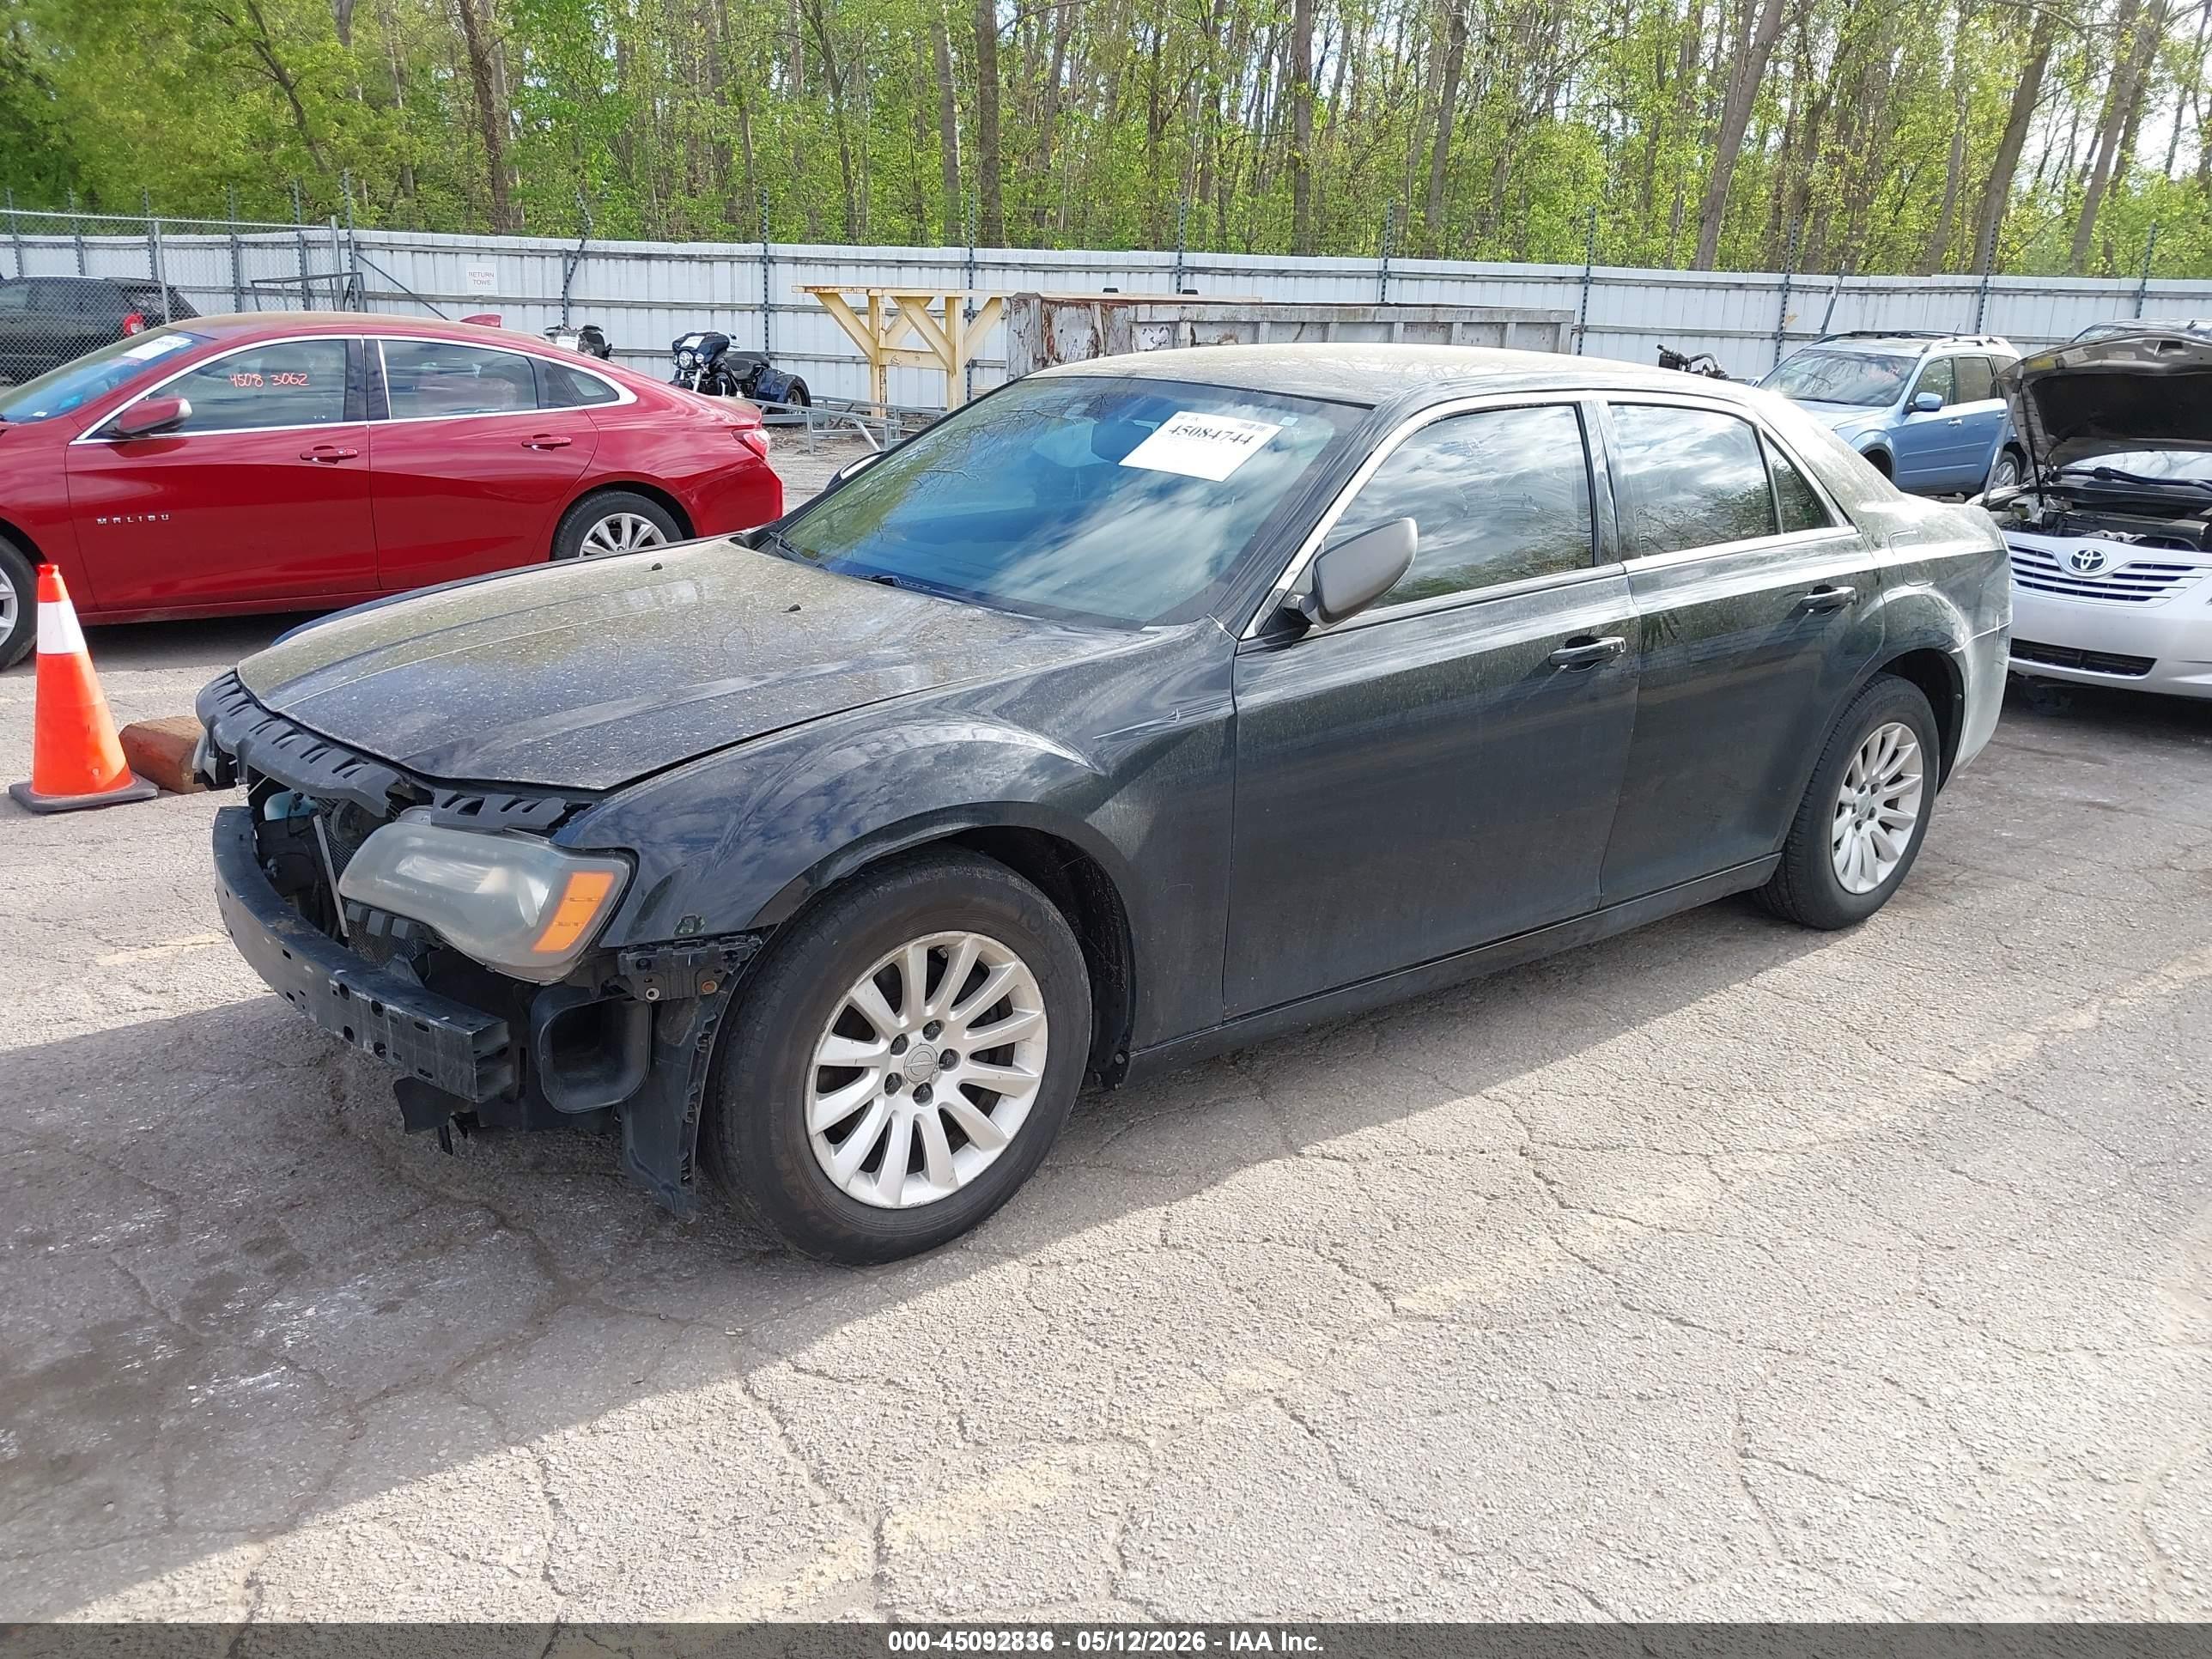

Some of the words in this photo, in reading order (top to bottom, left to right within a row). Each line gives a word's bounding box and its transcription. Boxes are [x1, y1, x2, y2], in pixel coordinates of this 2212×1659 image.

[229, 373, 264, 388] 4508
[270, 372, 310, 386] 3062
[1169, 423, 1255, 445] 45084744
[95, 513, 171, 526] MALIBU
